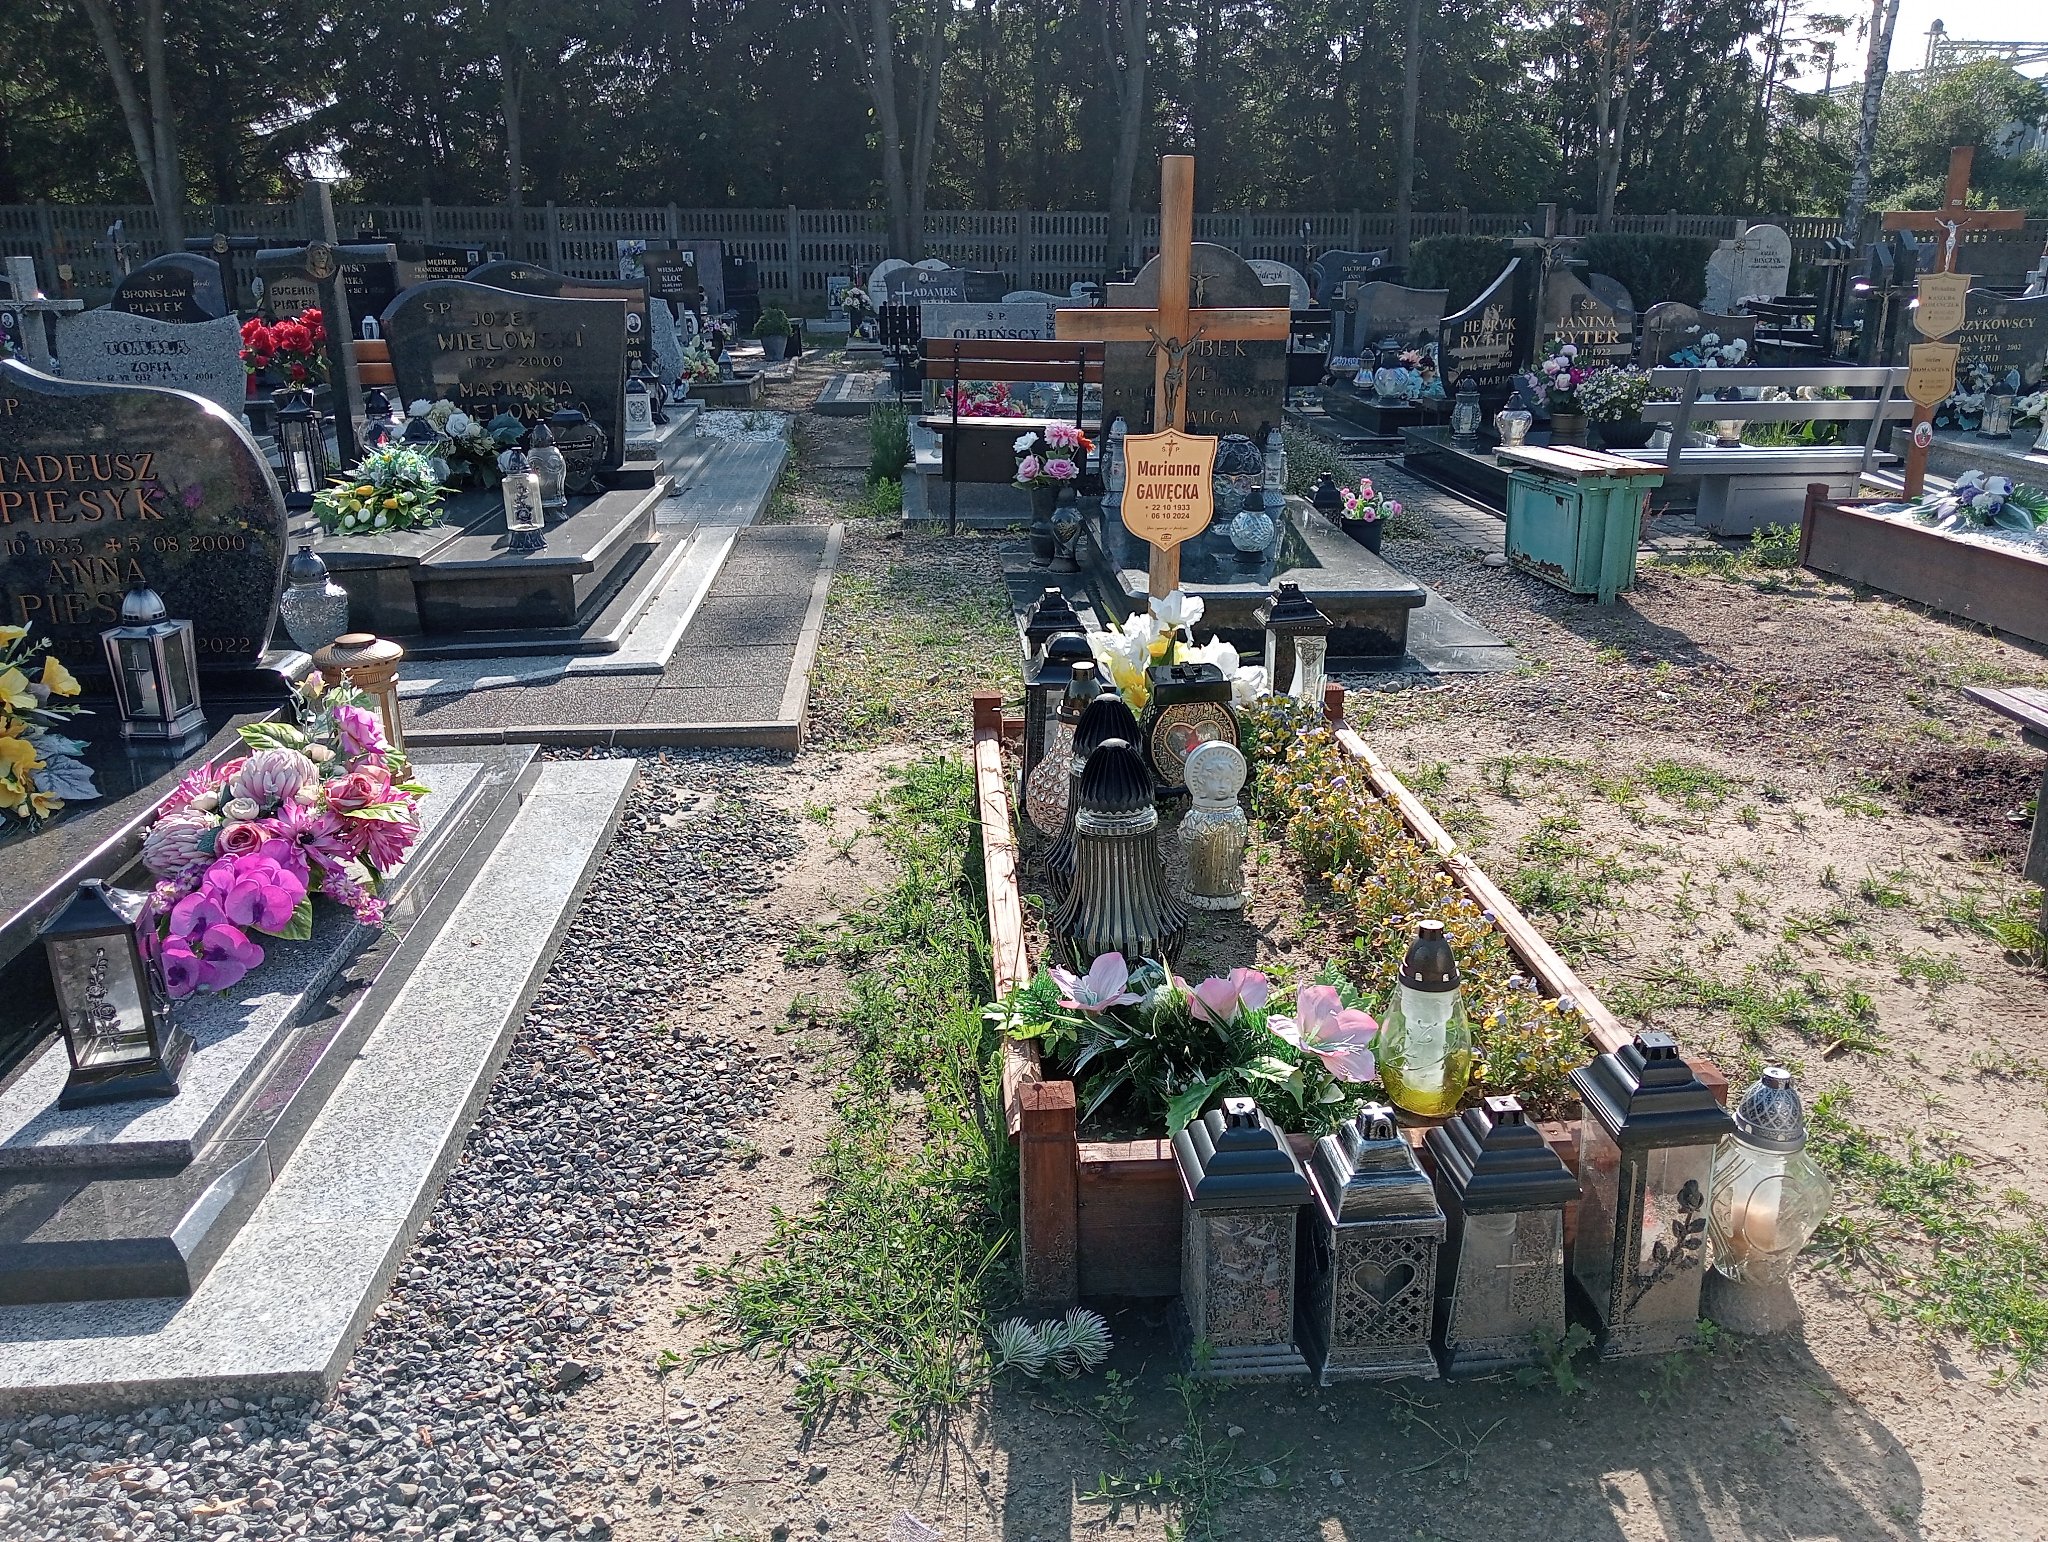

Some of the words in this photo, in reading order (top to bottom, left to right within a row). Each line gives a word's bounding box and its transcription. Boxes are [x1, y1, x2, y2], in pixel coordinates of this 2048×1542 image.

[913, 287, 958, 297] ADAMEK
[1463, 318, 1517, 333] HENRYK
[1557, 316, 1617, 329] JANINA
[953, 326, 1041, 340] OLBIŃSCY
[1959, 334, 1999, 344] DANUTA
[1460, 332, 1515, 350] RYTER
[131, 361, 172, 373] ZOFIA
[1137, 460, 1201, 477] Marianna
[1136, 483, 1200, 503] GAWĘCKA
[0, 487, 164, 524] PIESYK
[1151, 512, 1161, 520] 06
[1163, 512, 1171, 520] 10
[129, 537, 141, 552] 5
[153, 536, 179, 553] 08
[189, 534, 246, 552] 2000
[48, 556, 147, 585] ANNA
